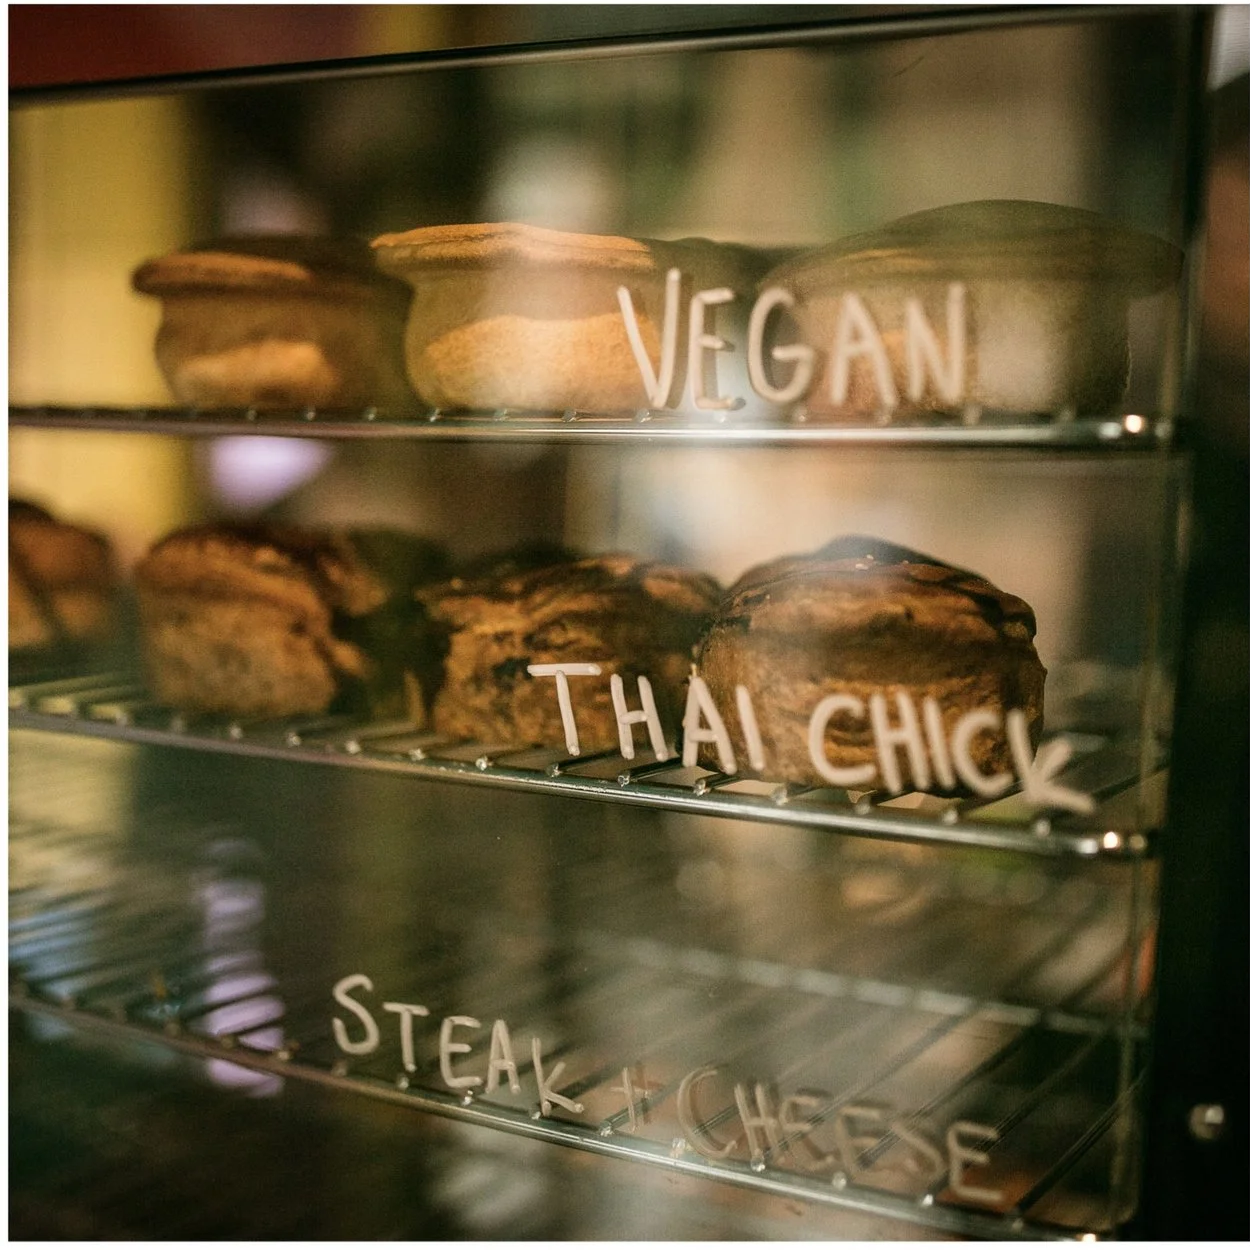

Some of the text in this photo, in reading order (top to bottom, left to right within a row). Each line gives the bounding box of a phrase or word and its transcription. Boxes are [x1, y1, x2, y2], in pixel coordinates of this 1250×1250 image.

[616, 267, 968, 411] VEGAN
[526, 662, 1096, 815] THAI CHICK
[332, 973, 587, 1117] STEAK
[677, 1062, 1008, 1203] CHEESE
